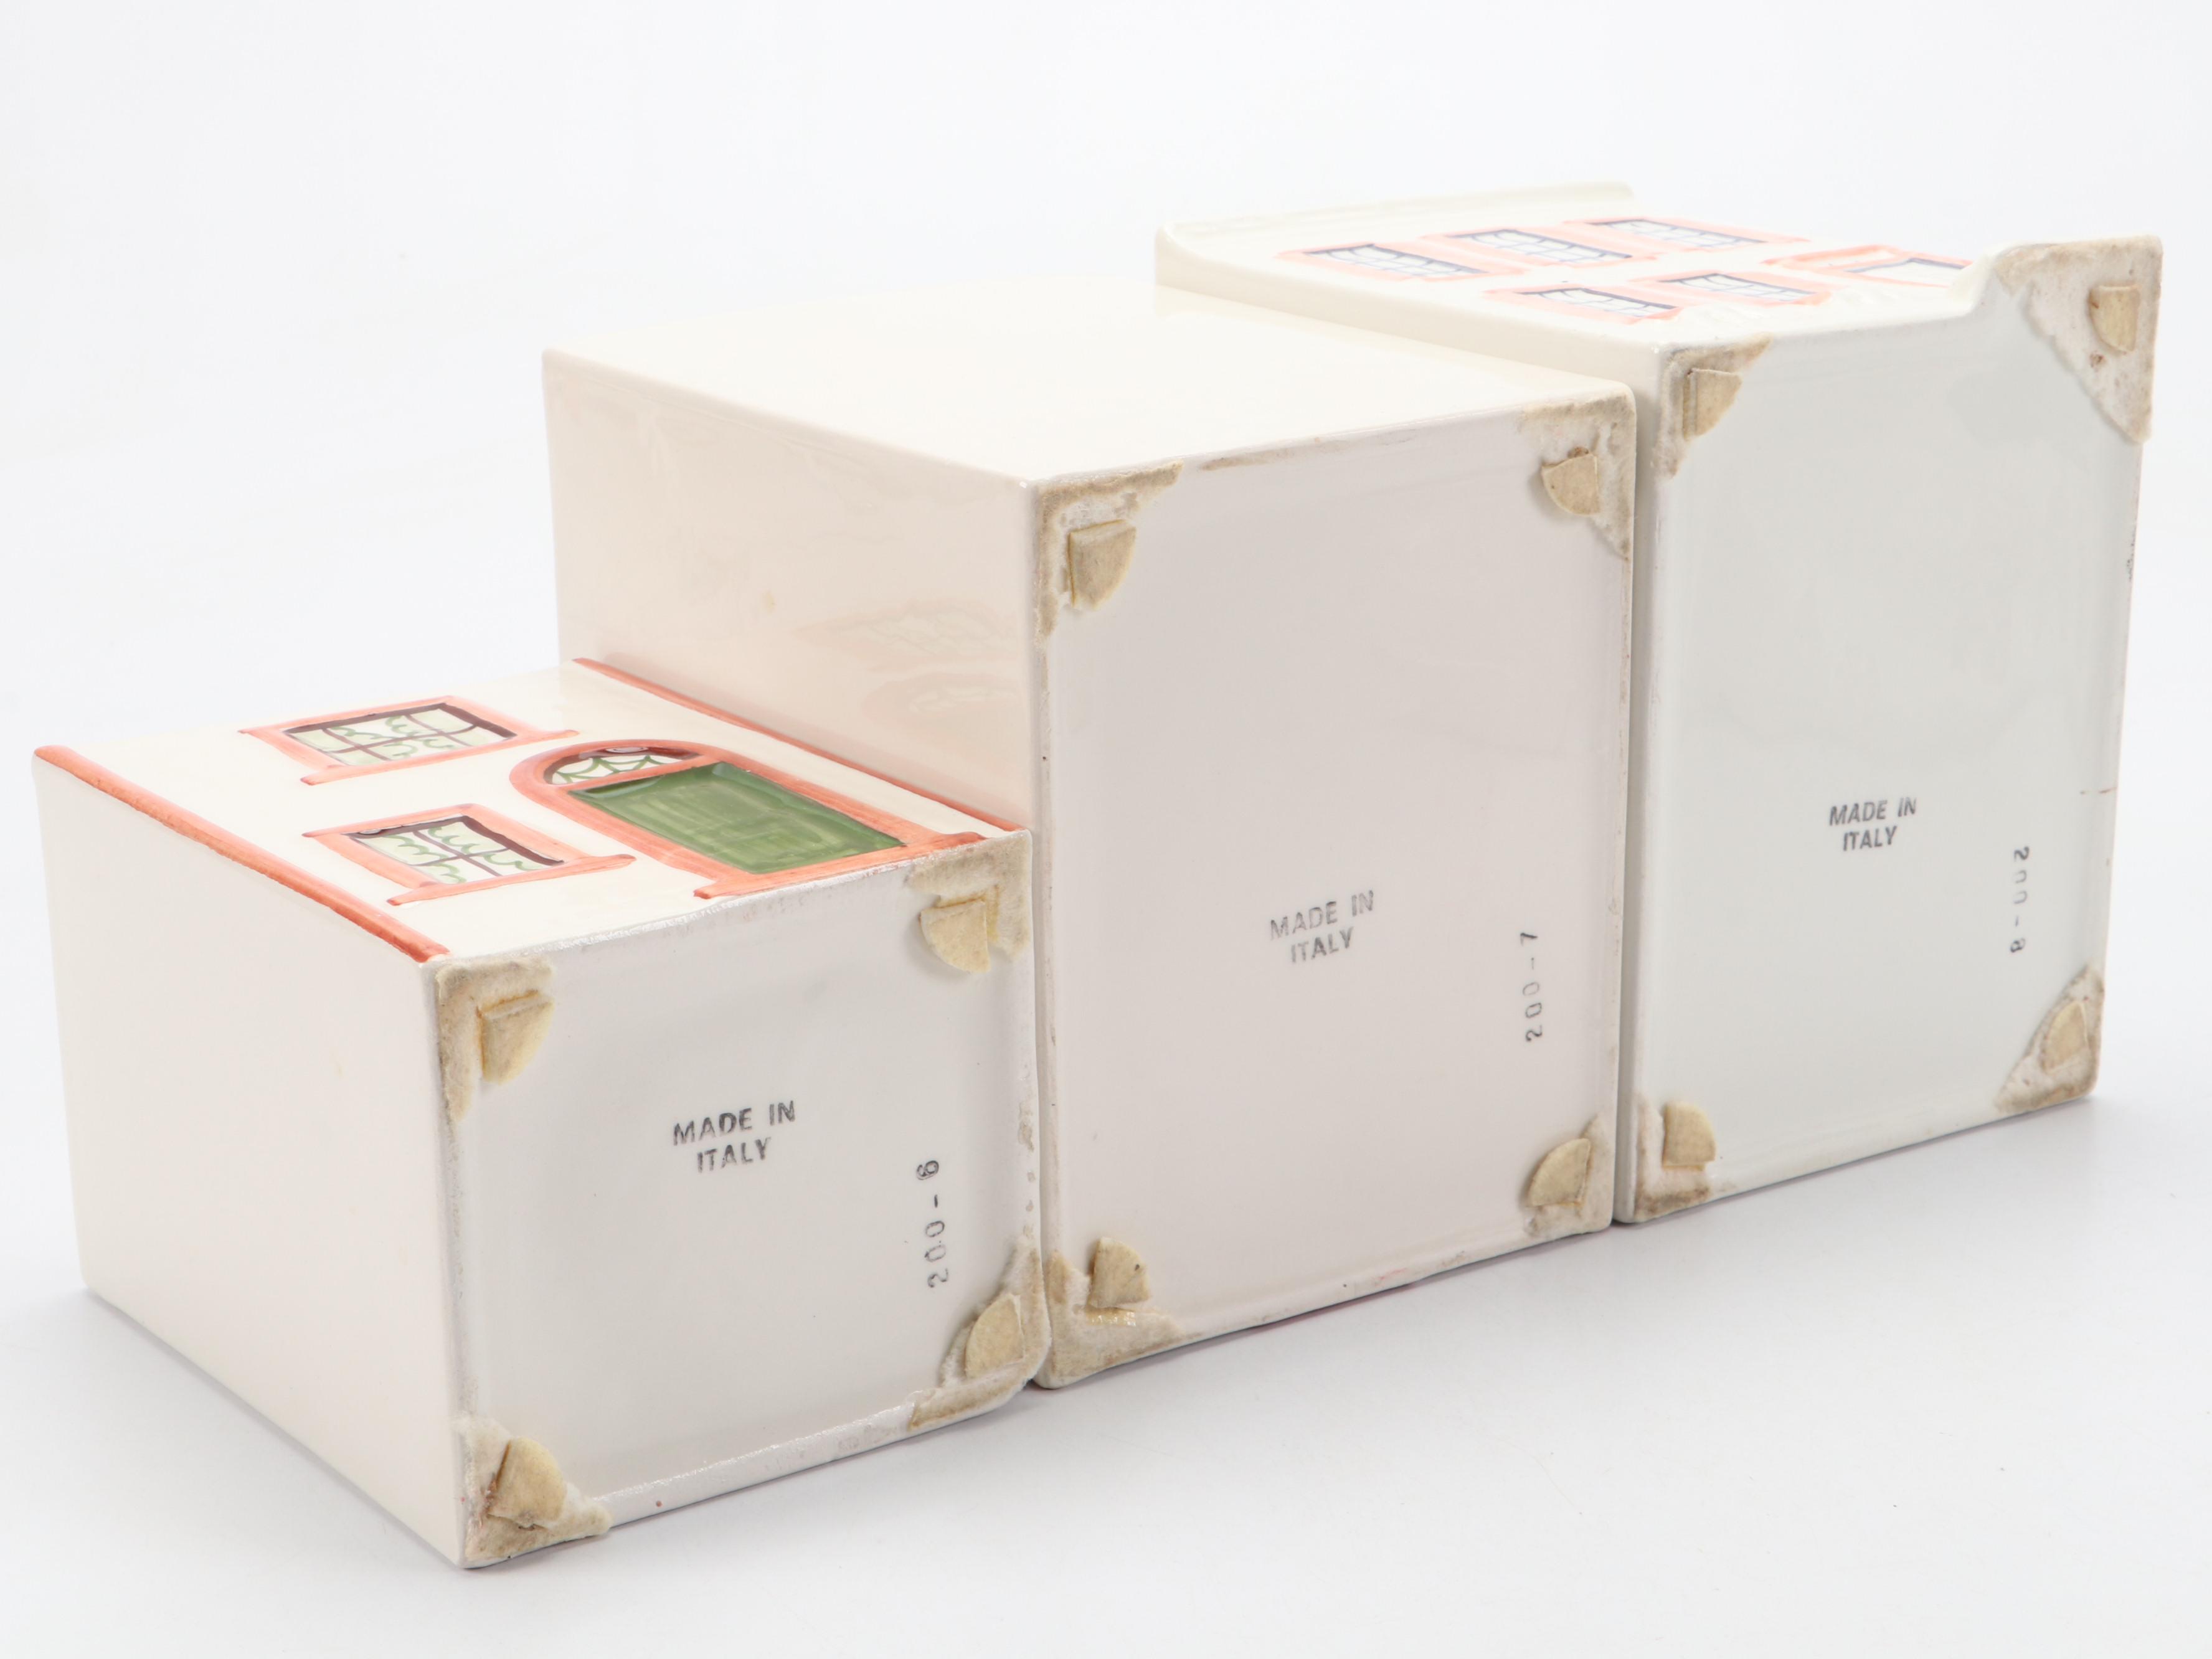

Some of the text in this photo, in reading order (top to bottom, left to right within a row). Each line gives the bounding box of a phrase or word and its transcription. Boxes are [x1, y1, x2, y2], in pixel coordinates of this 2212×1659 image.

[1828, 796, 1917, 826] MADE IN
[1843, 825, 1898, 852] ITALY
[1270, 889, 1374, 940] MADE IN
[1290, 927, 1354, 963] ITALY
[1519, 932, 1544, 1044] 200-7
[673, 1100, 796, 1146] MADE IN
[697, 1137, 772, 1173] ITALY
[915, 1160, 950, 1288] 200-6
